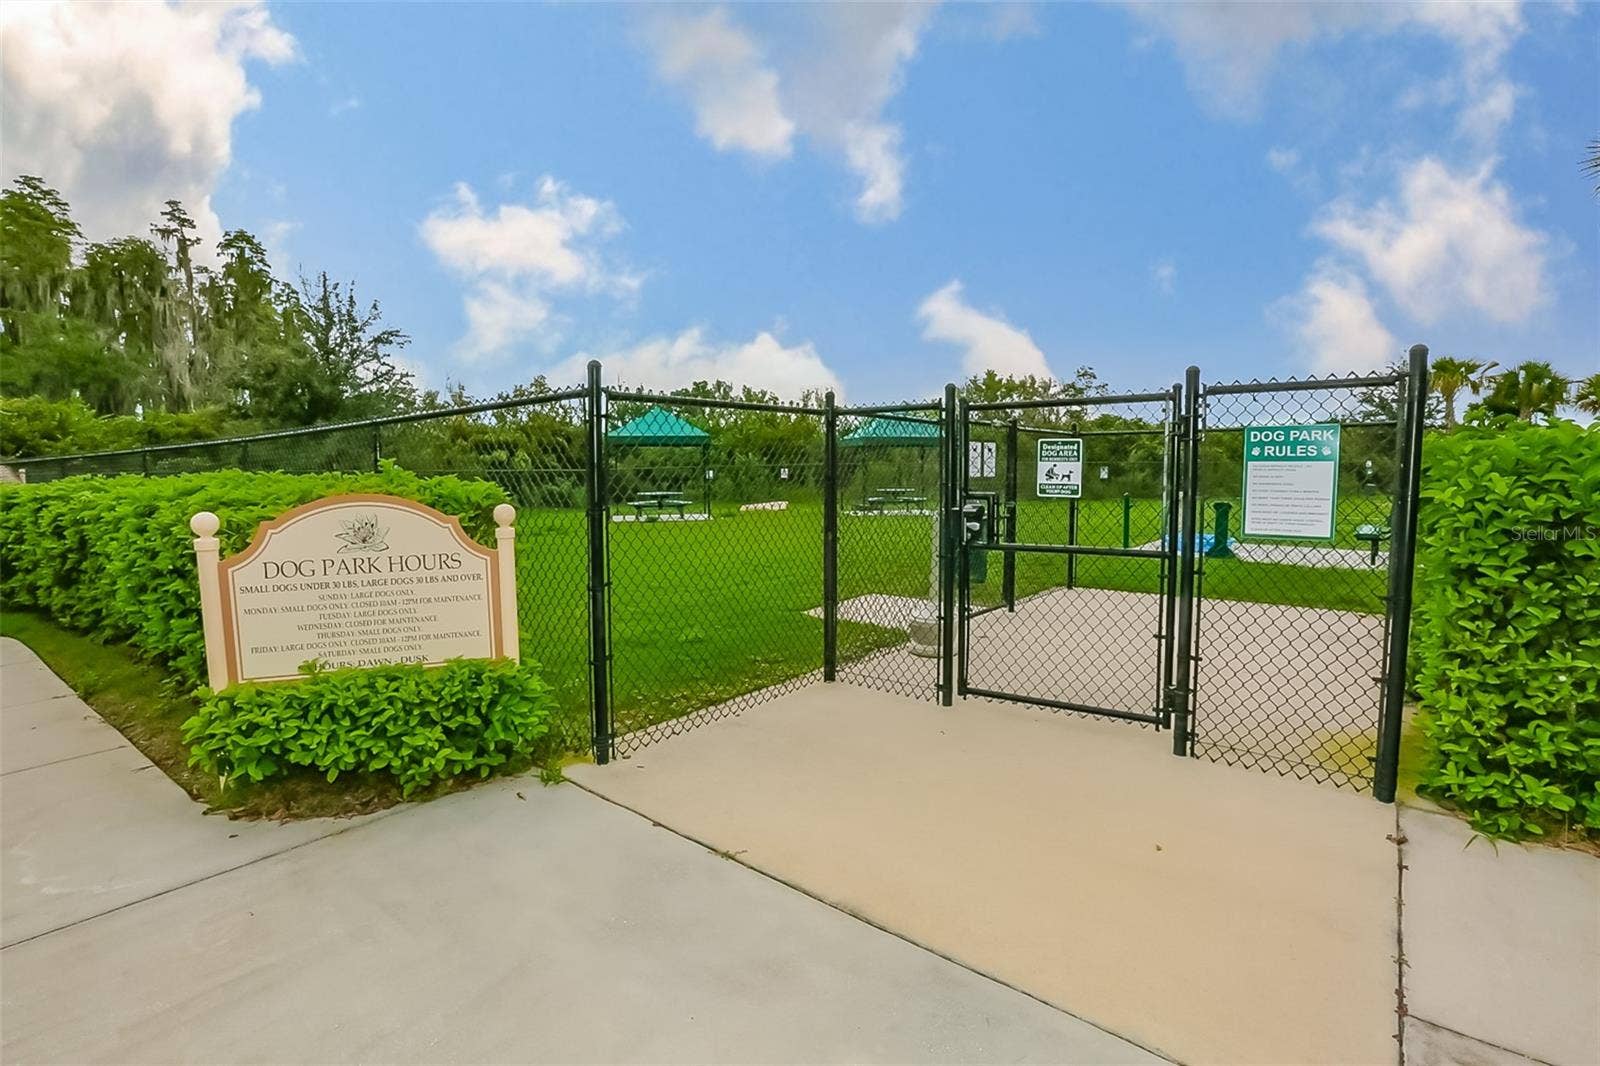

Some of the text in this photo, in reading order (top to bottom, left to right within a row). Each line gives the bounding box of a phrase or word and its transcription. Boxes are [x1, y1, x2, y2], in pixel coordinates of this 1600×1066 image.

[1250, 429, 1334, 442] DOG PARK
[1264, 445, 1318, 456] RULES
[262, 552, 462, 579] DOG PARK HOURS
[240, 585, 270, 594] SMALL
[272, 583, 298, 592] DOGS
[300, 582, 330, 591] UNDER
[342, 580, 359, 589] LBS,
[361, 578, 388, 587] LARGE
[390, 576, 414, 585] DOGS
[416, 576, 424, 584] 30
[425, 575, 439, 584] LBS
[440, 574, 458, 582] AND
[460, 573, 483, 581] OVER.
[351, 591, 373, 599] LARGE
[353, 609, 375, 618] LARGE
[345, 620, 372, 628] CLOSED
[358, 628, 381, 637] SMALL
[281, 644, 305, 652] LARGE
[350, 638, 378, 646] CLOSED
[359, 646, 382, 655] SMALL
[358, 658, 392, 667] DAWN
[400, 655, 429, 663] DUSK
